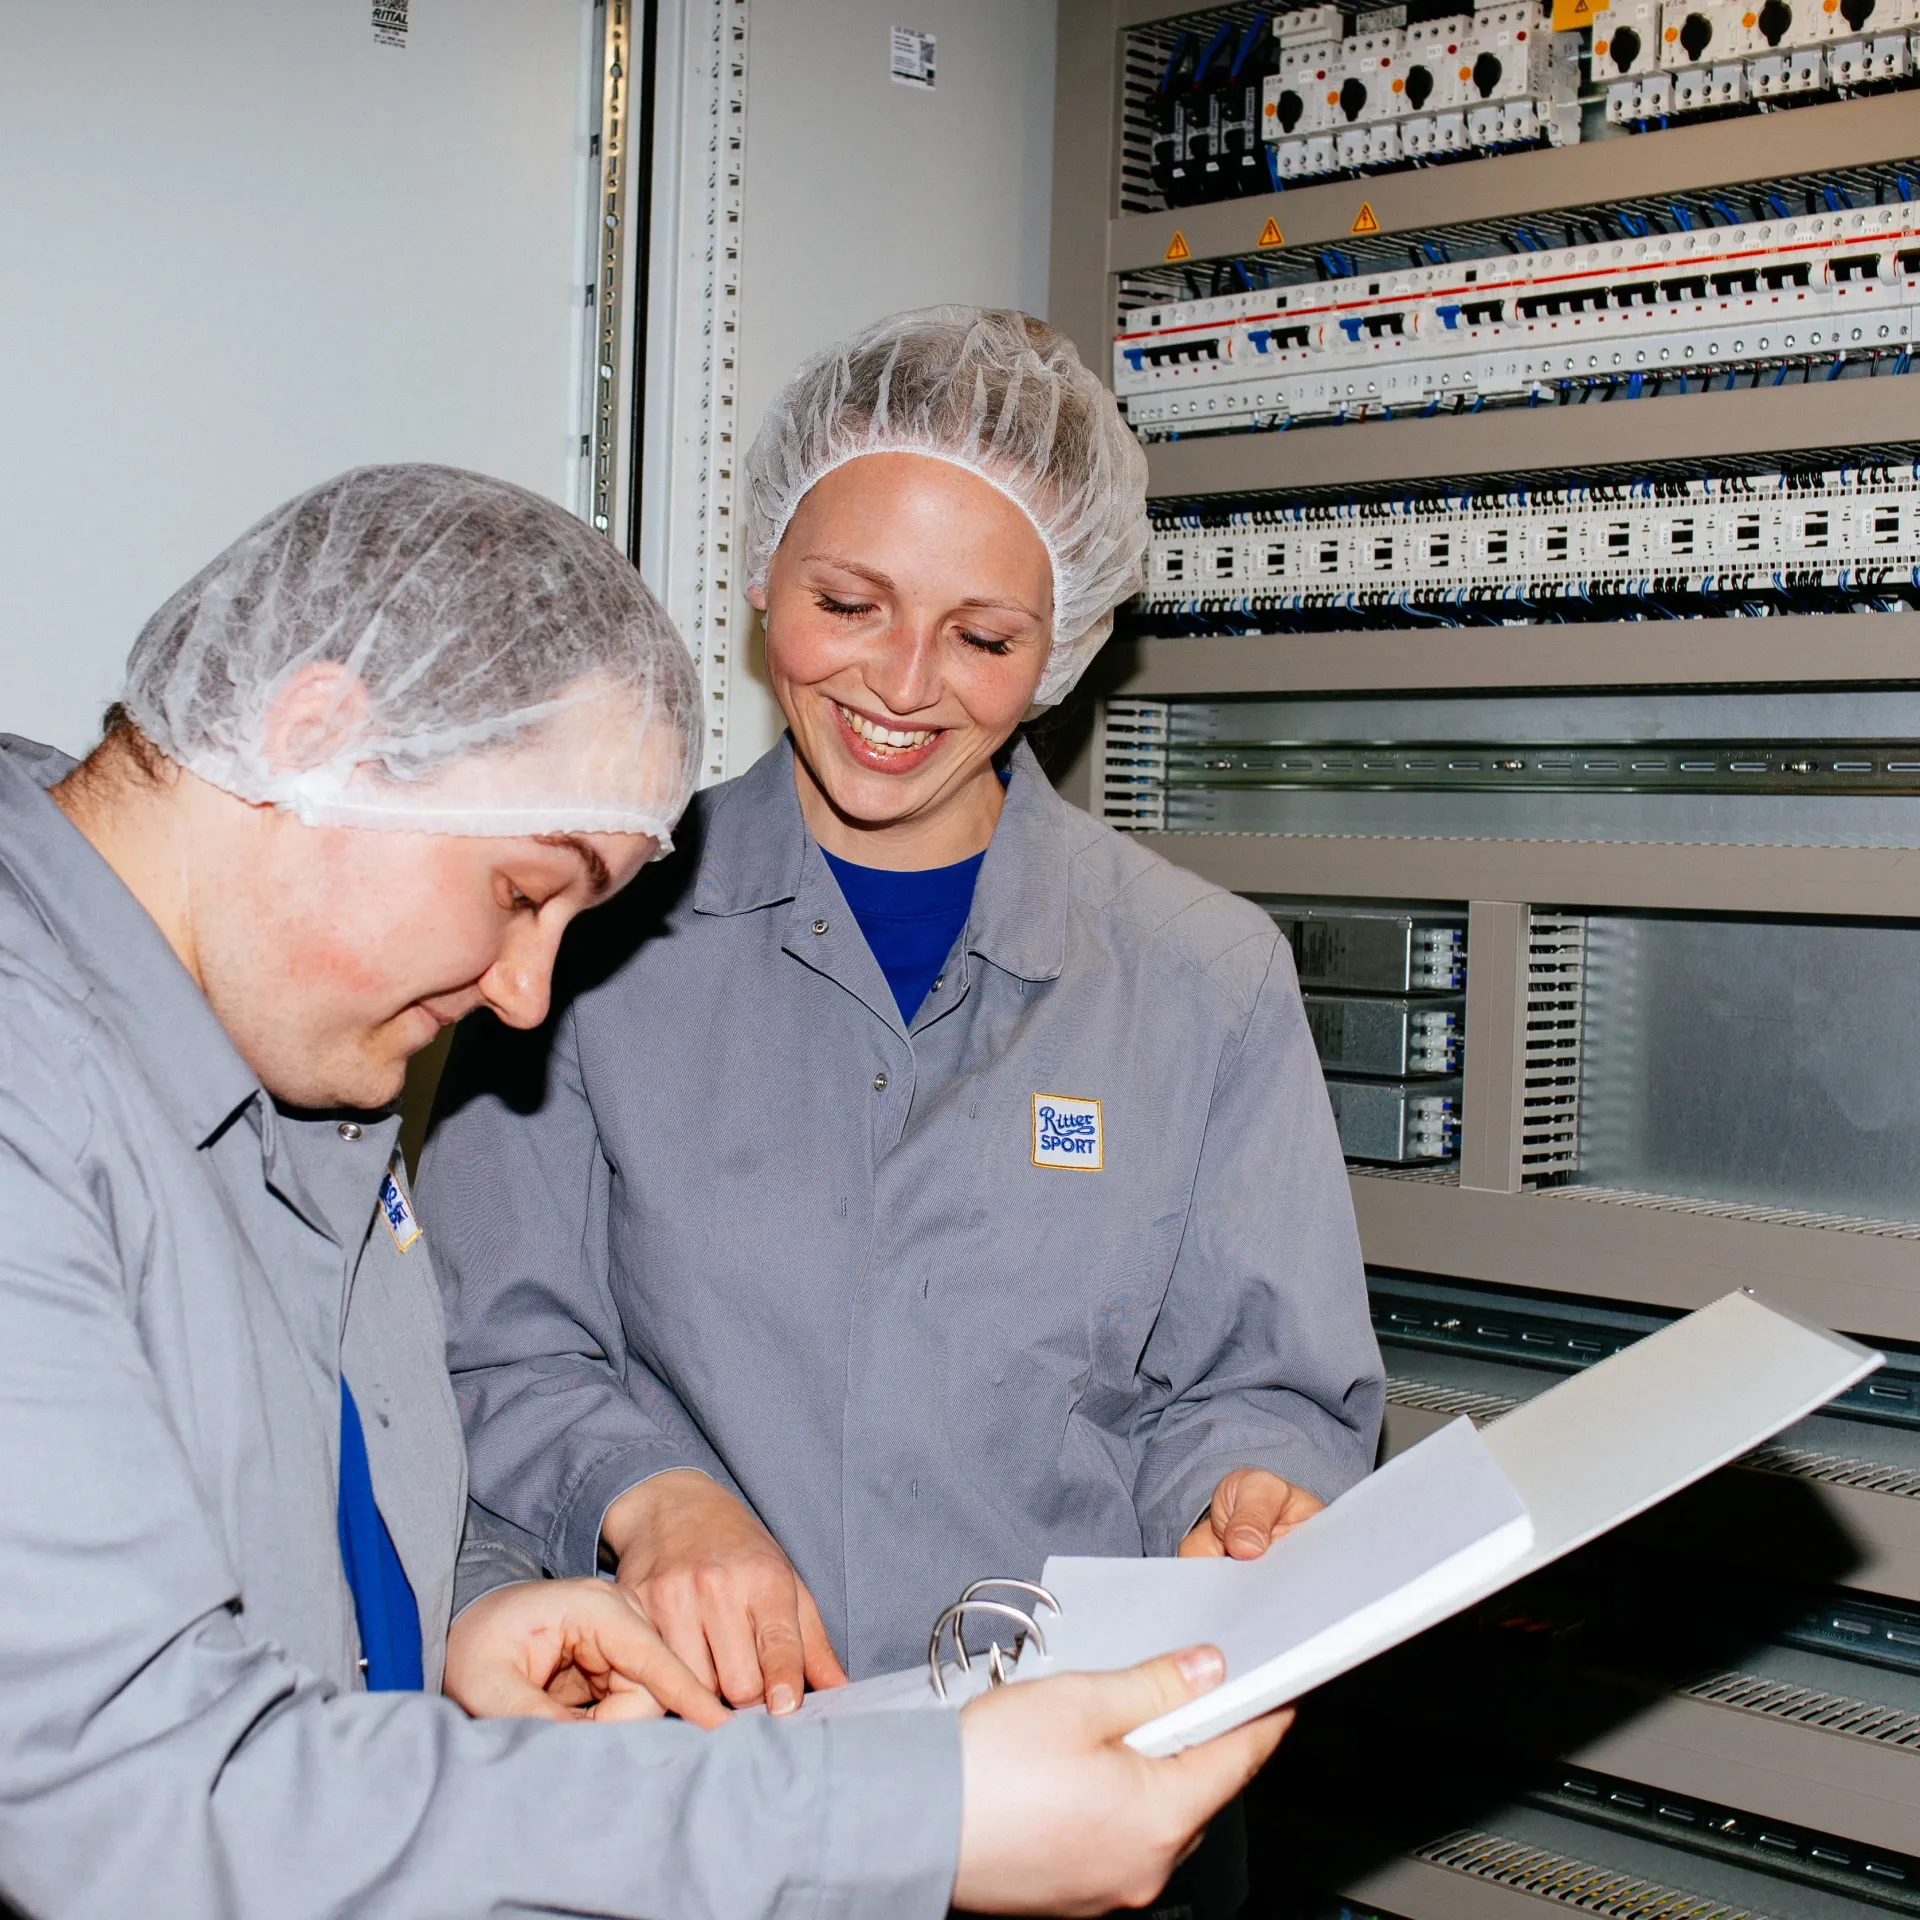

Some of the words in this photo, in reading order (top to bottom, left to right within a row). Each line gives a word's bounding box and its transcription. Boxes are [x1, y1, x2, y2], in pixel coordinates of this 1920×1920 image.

[372, 8, 408, 24] RITTAL
[1039, 1106, 1095, 1136] Ritter
[1041, 1134, 1095, 1154] SPORT
